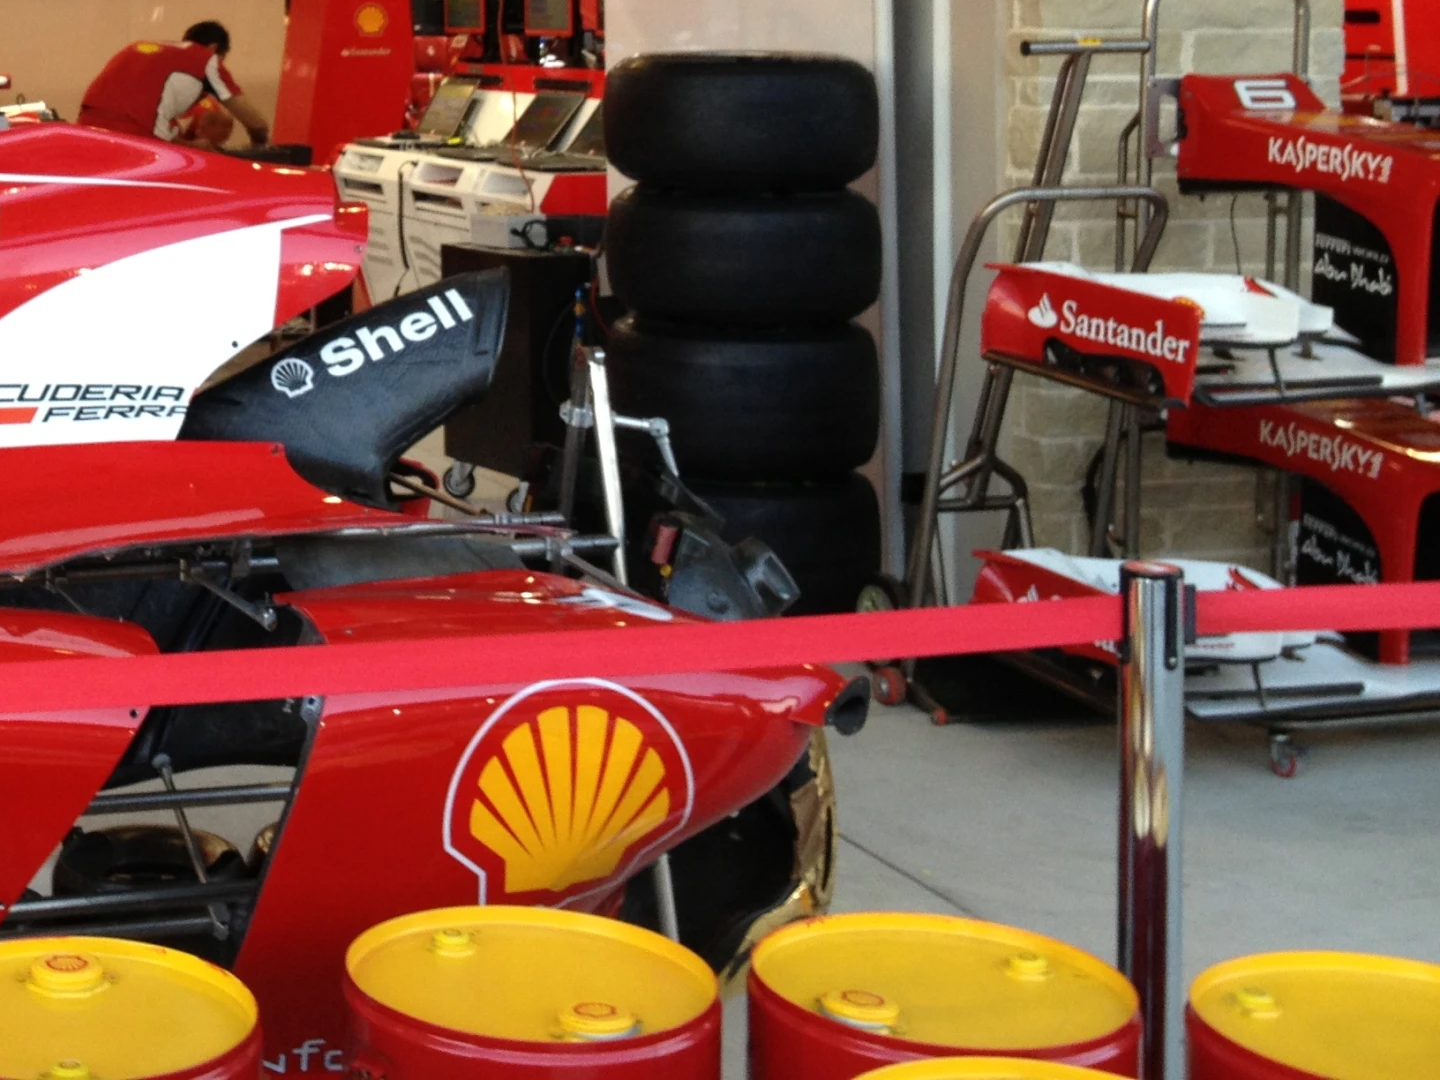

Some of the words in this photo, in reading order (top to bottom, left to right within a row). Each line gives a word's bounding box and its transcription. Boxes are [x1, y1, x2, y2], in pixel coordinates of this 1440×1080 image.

[1233, 79, 1298, 111] 6
[319, 287, 475, 378] Shell
[1060, 299, 1191, 363] Santander
